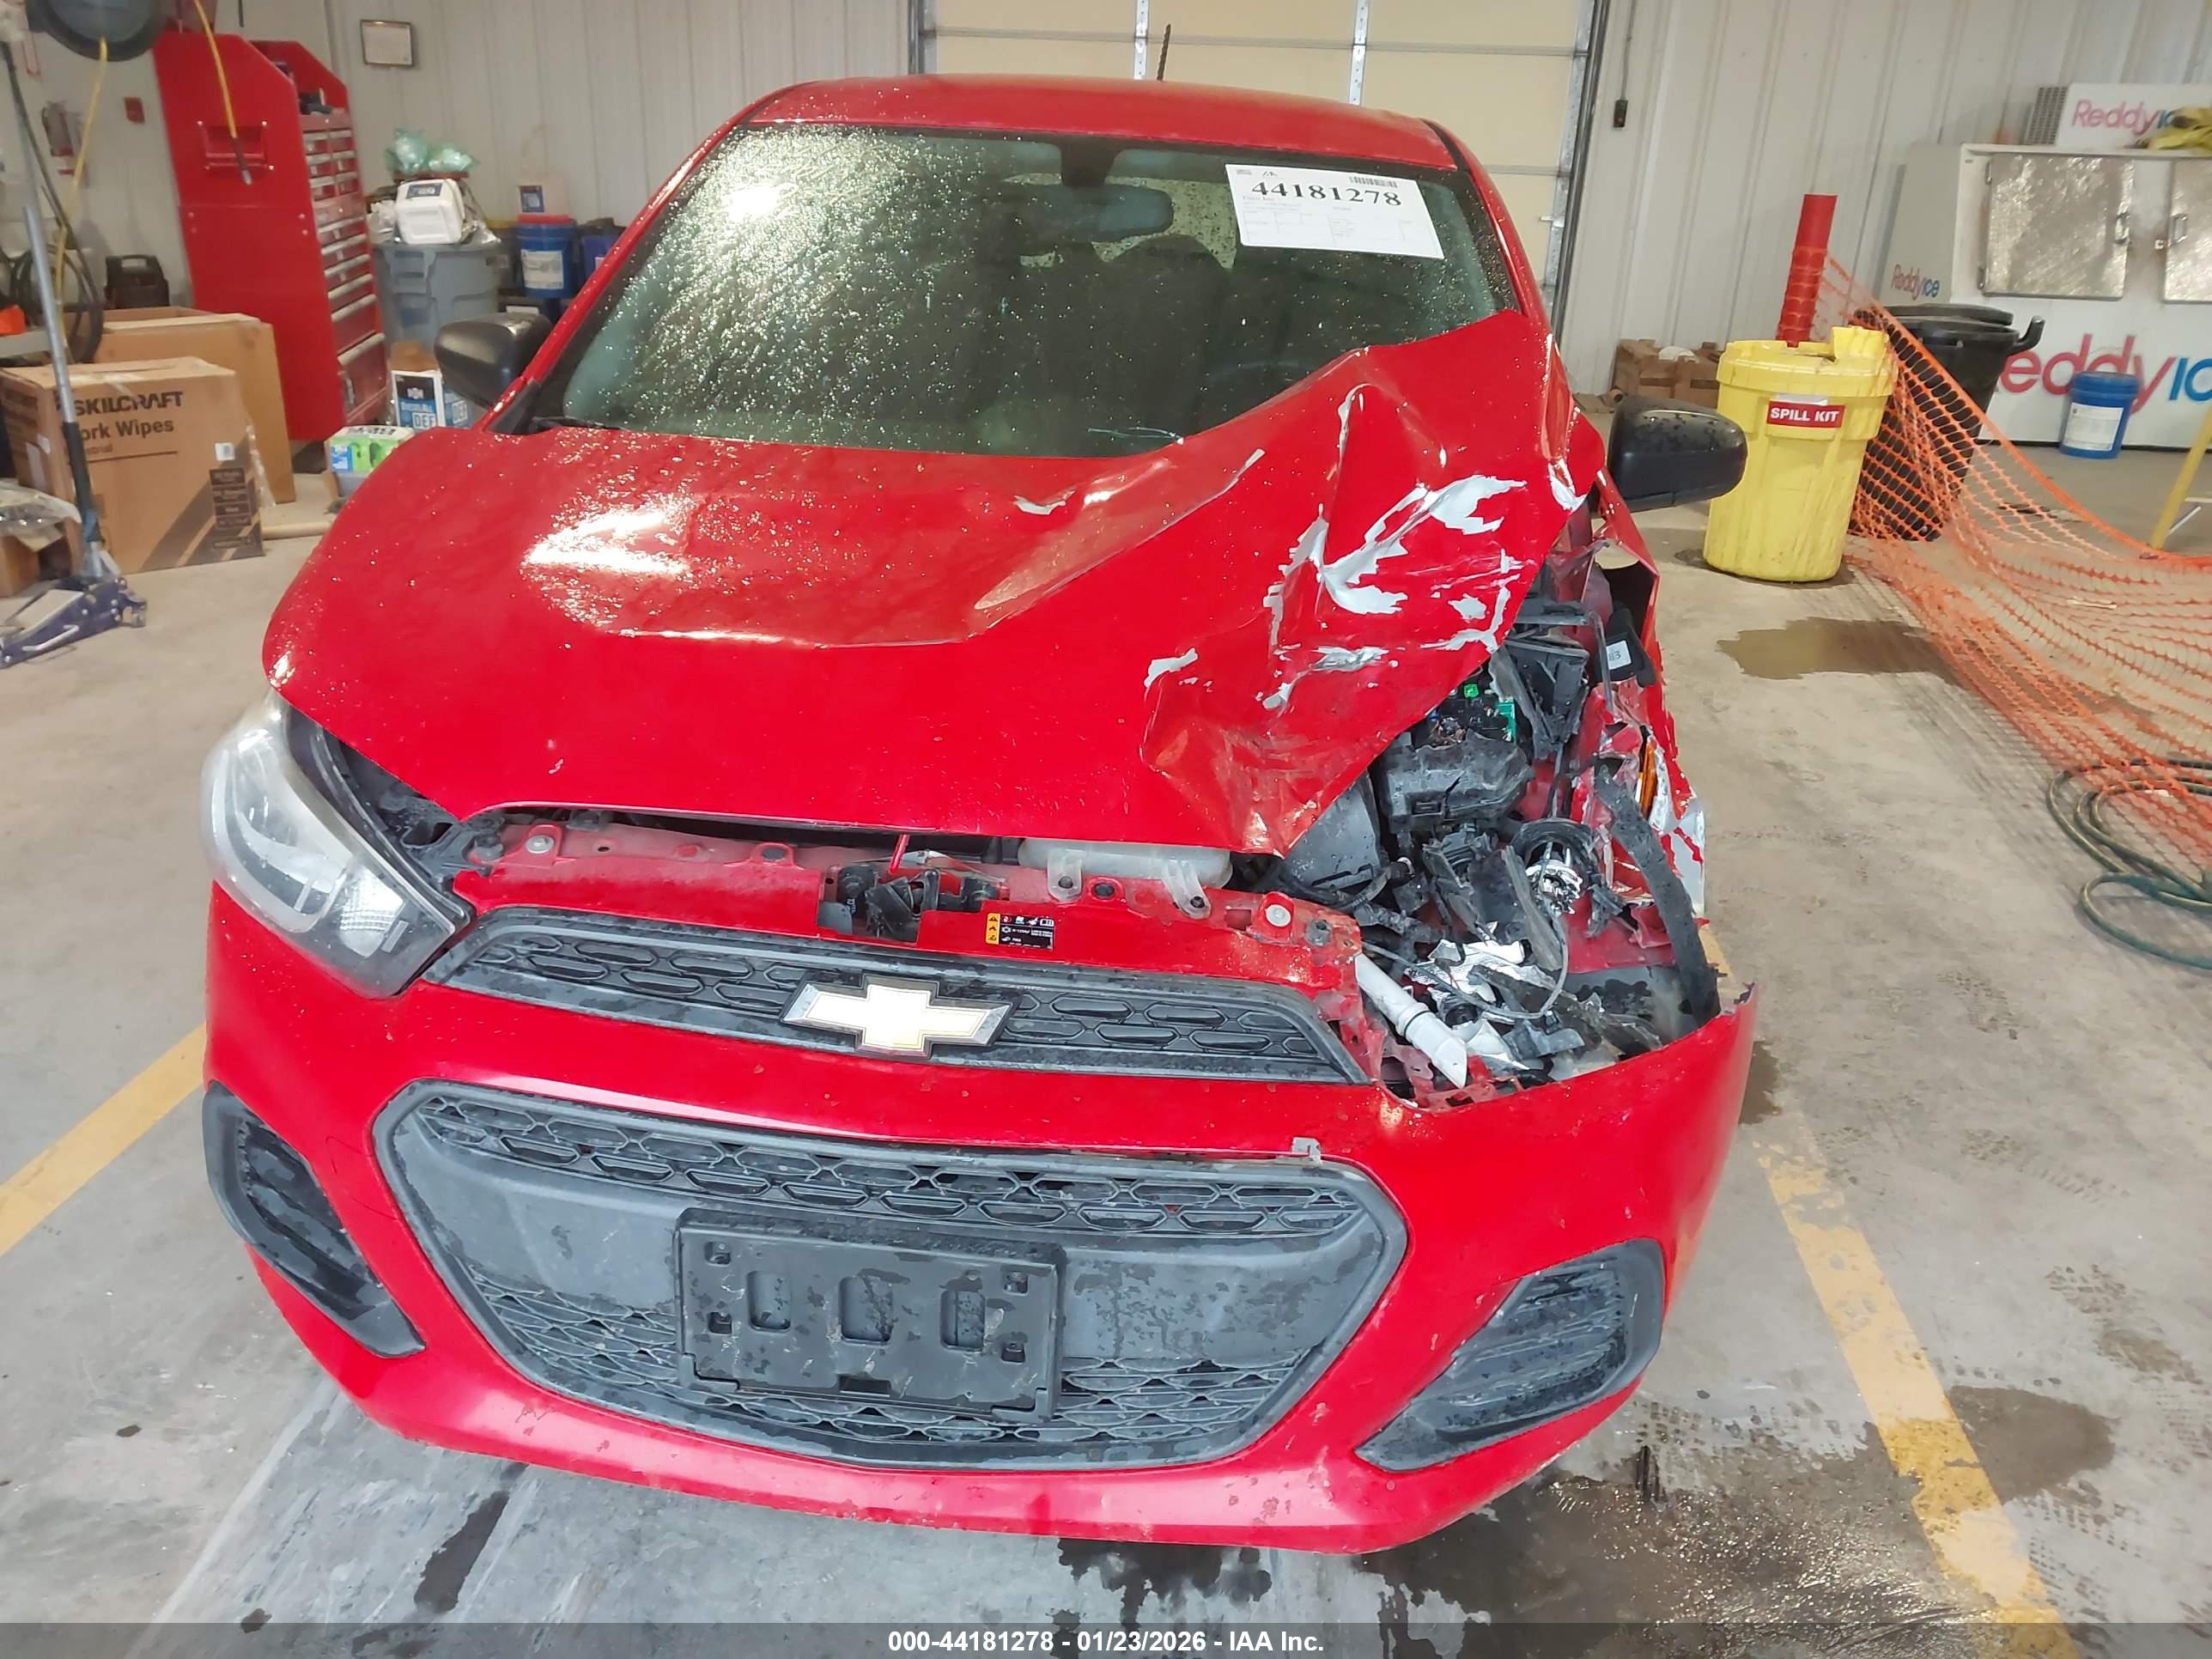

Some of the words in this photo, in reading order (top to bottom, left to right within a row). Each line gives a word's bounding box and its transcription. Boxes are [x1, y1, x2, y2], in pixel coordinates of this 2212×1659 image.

[1251, 181, 1402, 207] 44181278
[75, 391, 183, 416] SKILCRAFT
[414, 414, 434, 428] DEF
[1771, 408, 1810, 422] SPILL
[1814, 410, 1839, 422] KIT
[81, 422, 111, 441] ork
[115, 419, 174, 438] Wipes
